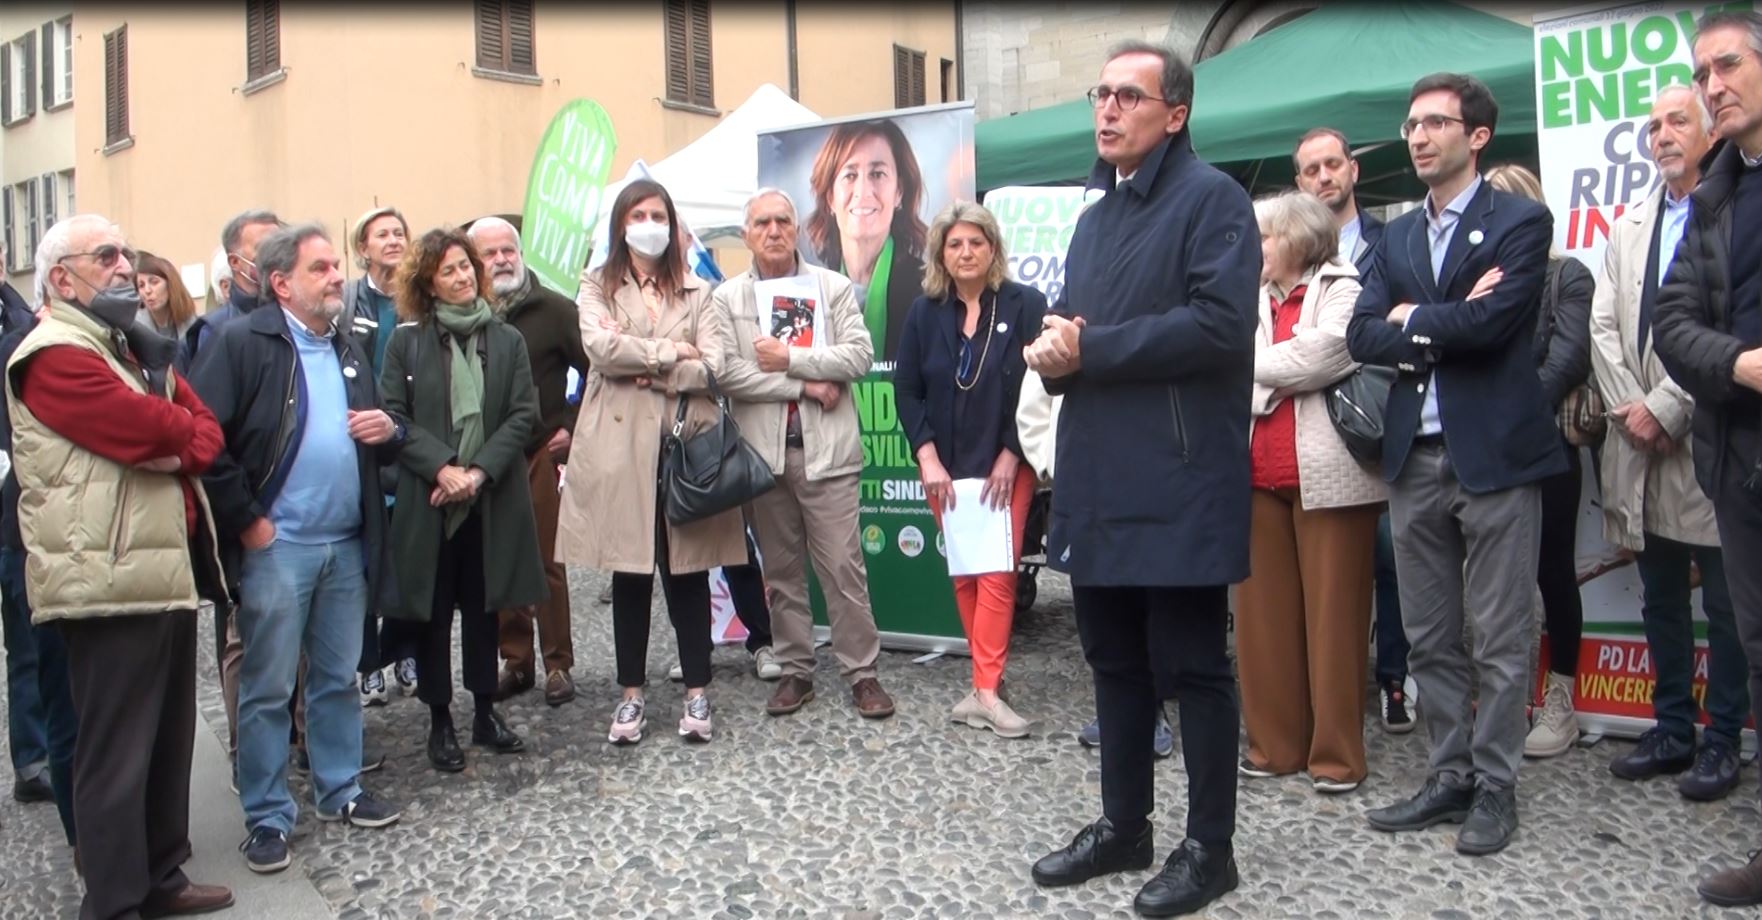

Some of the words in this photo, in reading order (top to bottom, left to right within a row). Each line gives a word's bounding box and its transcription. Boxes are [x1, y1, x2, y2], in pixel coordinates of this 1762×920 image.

[560, 111, 605, 179] VIVA
[538, 153, 600, 231] COMO
[531, 203, 586, 280] VIVA!
[1597, 645, 1624, 671] PD
[1627, 648, 1650, 674] LA
